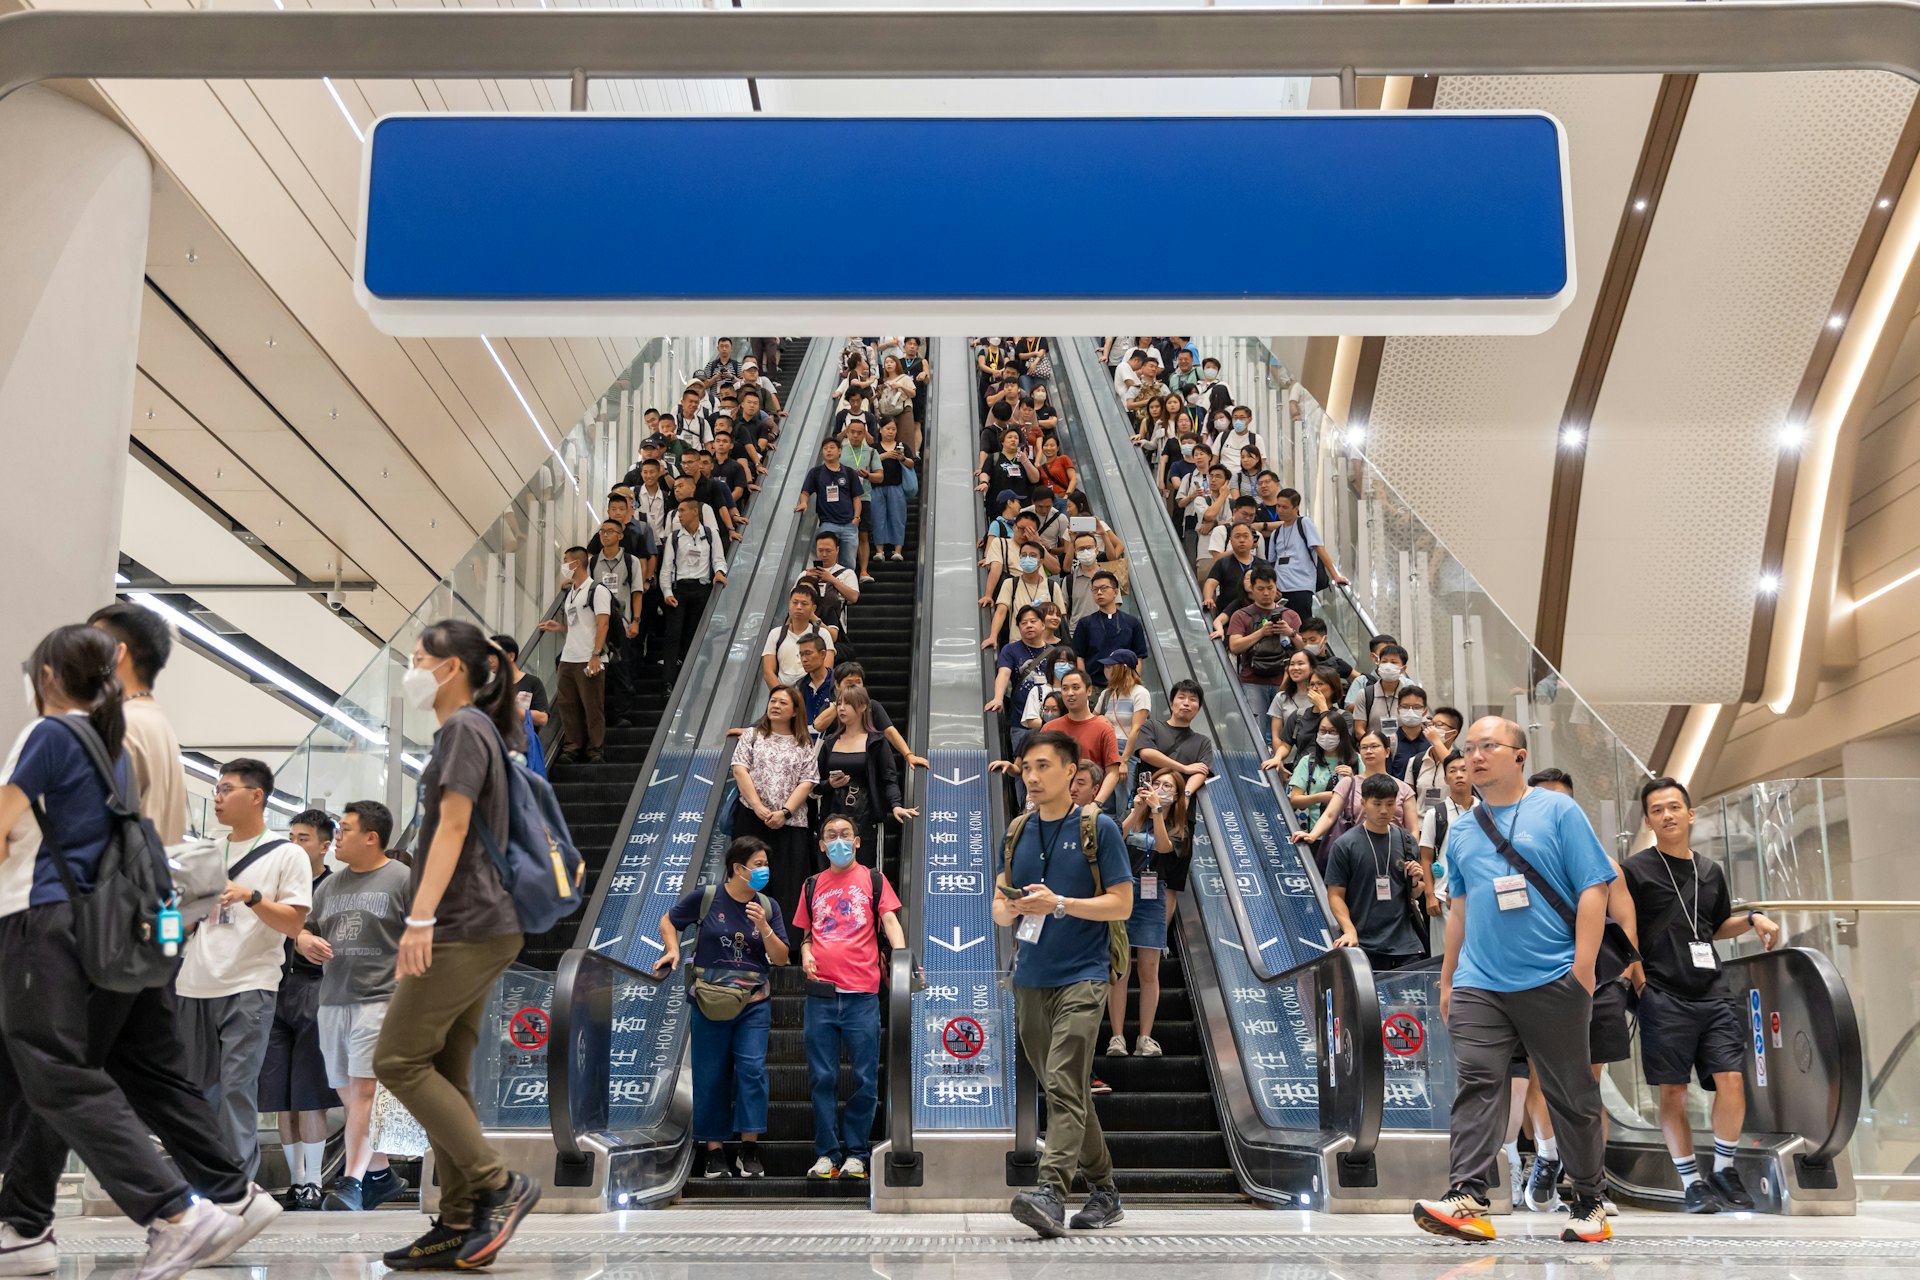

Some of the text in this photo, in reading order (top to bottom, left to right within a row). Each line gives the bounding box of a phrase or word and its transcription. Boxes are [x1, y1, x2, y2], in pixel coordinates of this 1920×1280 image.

[1222, 811, 1240, 832] KONG
[928, 810, 959, 867] 往香港
[969, 810, 984, 867] To HONG KONG
[1229, 834, 1249, 856] HONG
[1239, 858, 1252, 869] To
[936, 874, 977, 893] 港
[972, 984, 988, 1014] KONG
[1277, 985, 1302, 1016] KONG
[610, 984, 658, 1068] 往香港
[650, 984, 686, 1069] To HONG KONG
[1231, 986, 1289, 1070] 往香港
[1290, 1019, 1317, 1053] HONG
[934, 1080, 983, 1103] 港
[1270, 1082, 1320, 1105] 港
